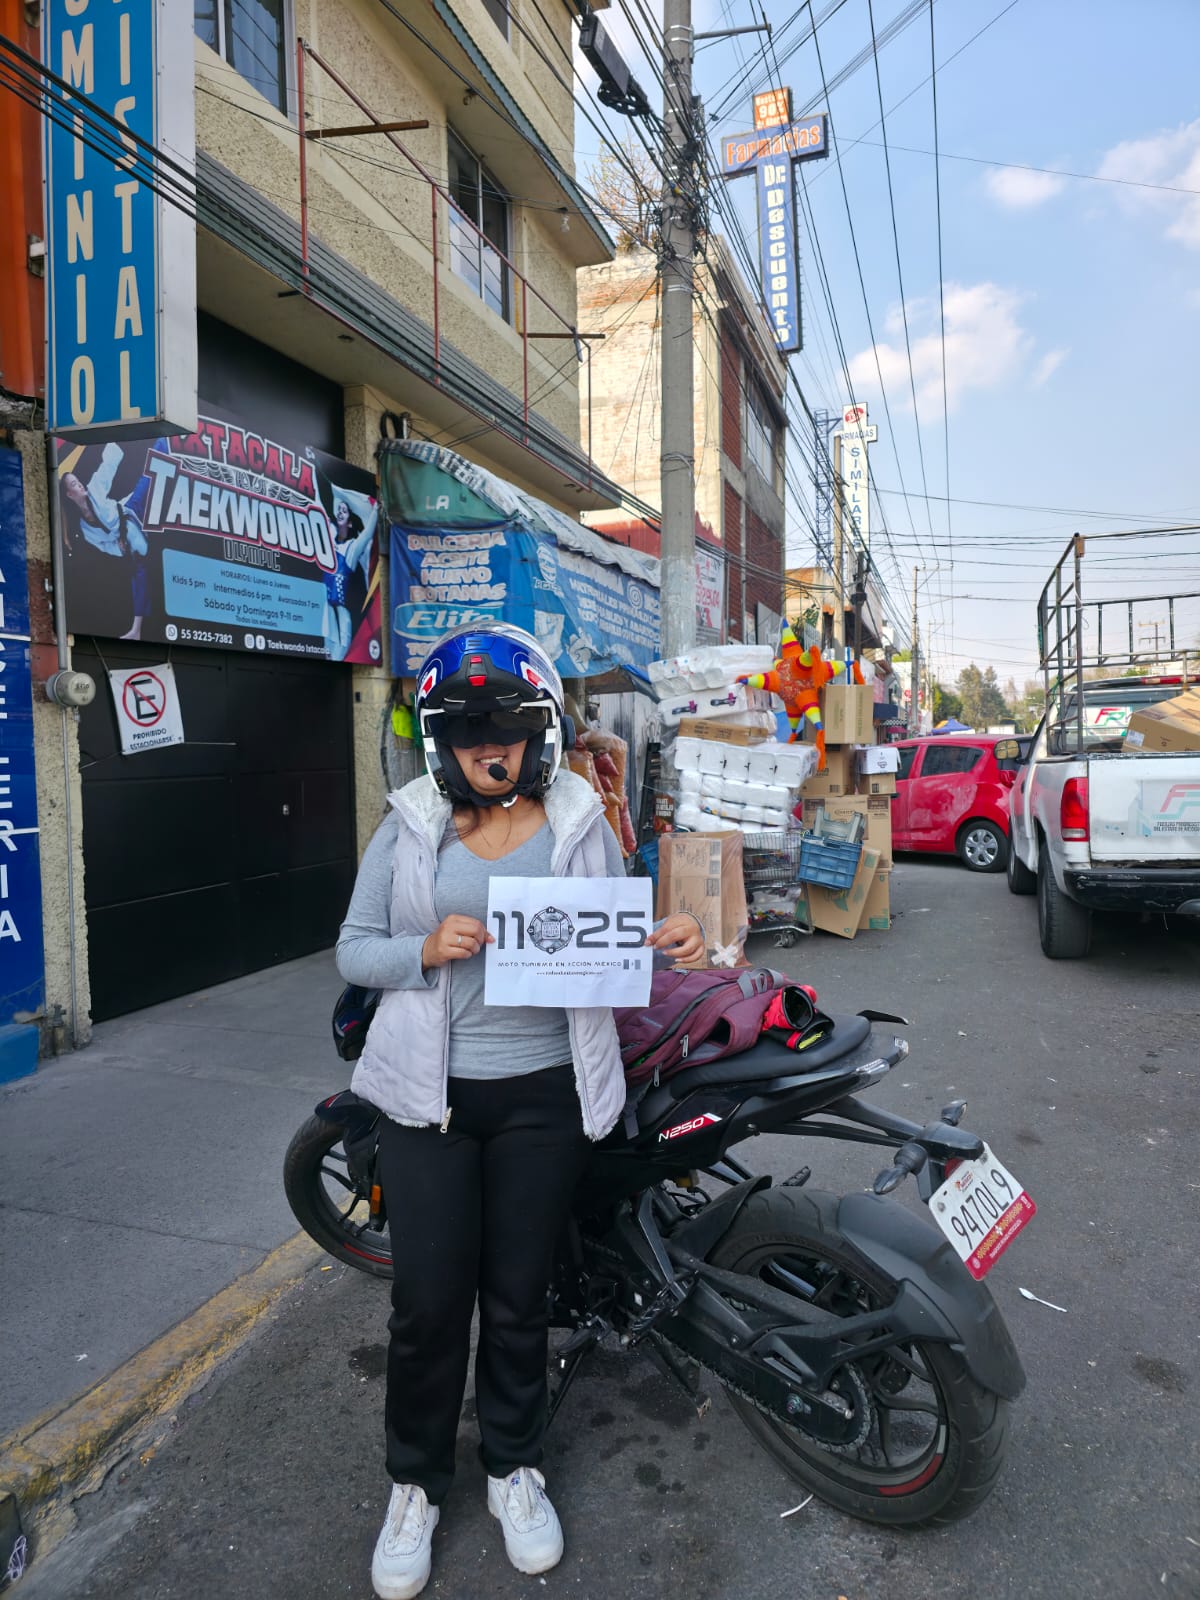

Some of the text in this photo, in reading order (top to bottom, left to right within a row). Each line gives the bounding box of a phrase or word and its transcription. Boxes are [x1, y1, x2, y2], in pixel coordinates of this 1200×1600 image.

[727, 125, 821, 166] Farmacias
[62, 0, 95, 425] MINIO
[113, 0, 143, 420] ISTAL
[147, 453, 337, 571] TAEKWONDO
[425, 495, 450, 511] LA
[224, 537, 281, 572] OLYMPIC
[421, 550, 489, 568] ACEITE
[172, 575, 206, 589] Kids 5 pm
[422, 566, 492, 585] HUEVO
[213, 583, 255, 599] Intermedios
[261, 593, 273, 602] pm
[236, 605, 242, 615] y
[242, 603, 279, 620] Domingos
[292, 614, 304, 622] am
[181, 628, 233, 645] 55 3225-7382
[266, 639, 305, 653] Taekwondo
[133, 727, 167, 740] PROHIBIDO
[658, 1116, 705, 1143] N250
